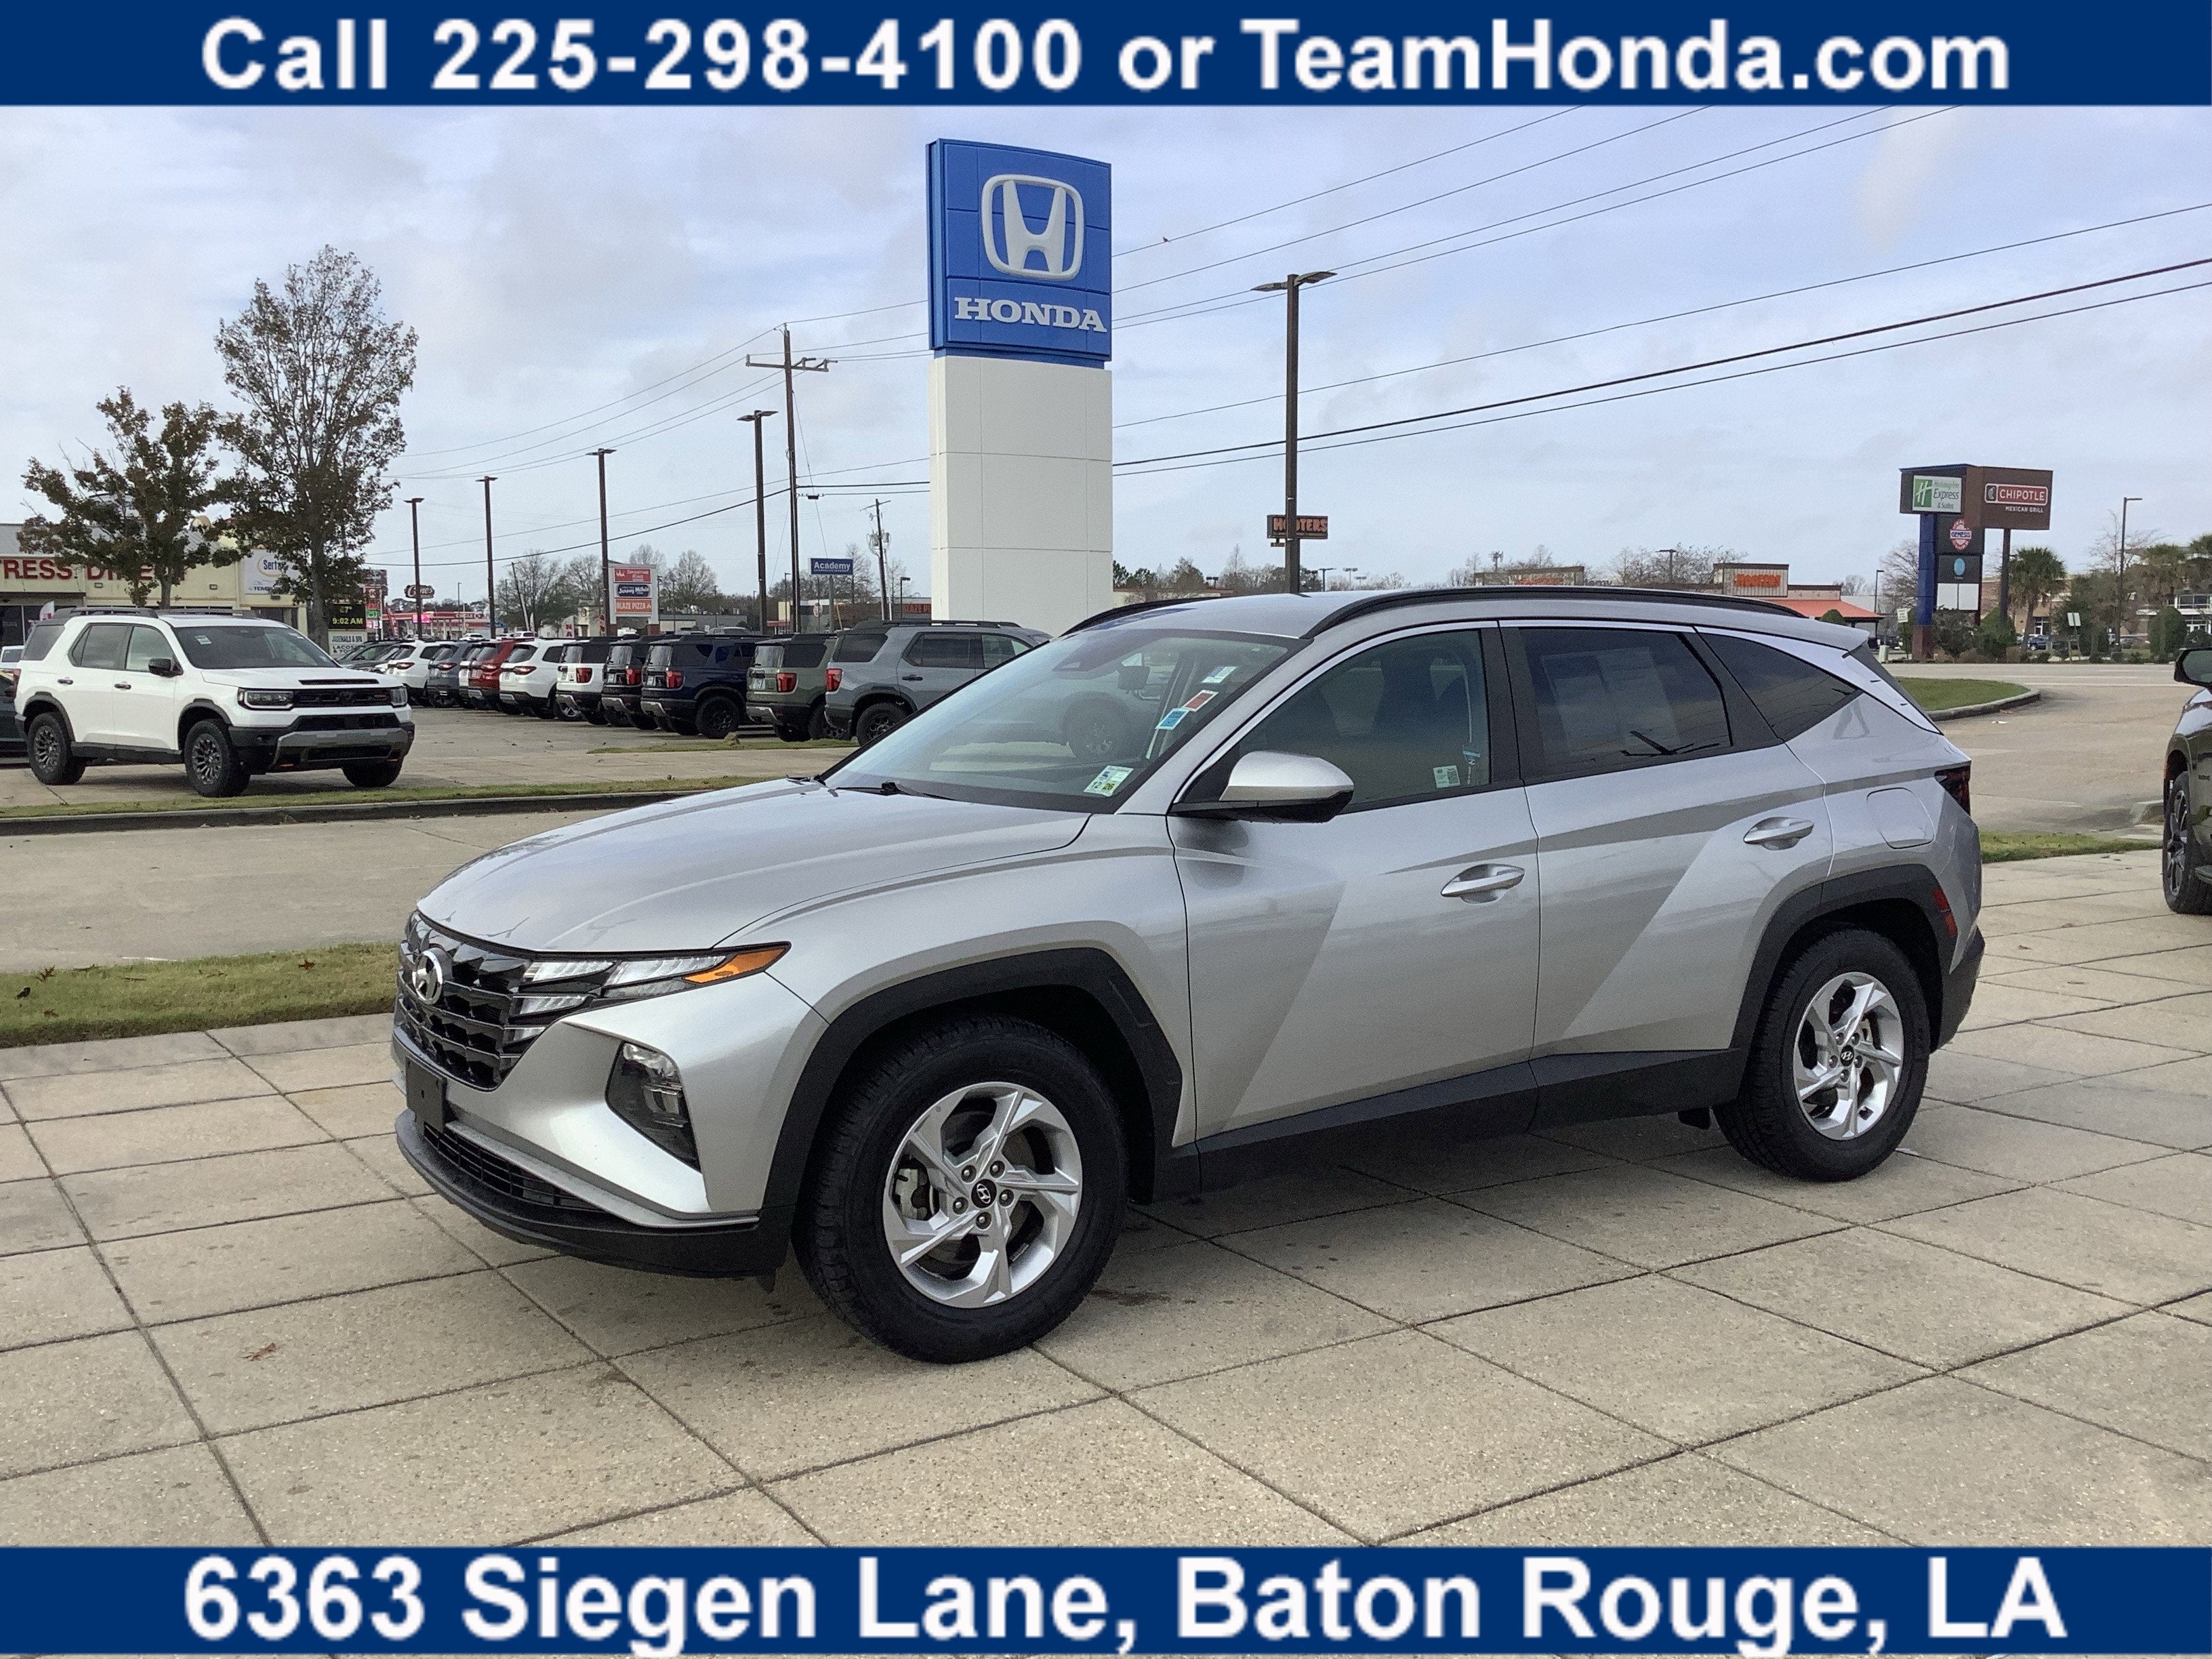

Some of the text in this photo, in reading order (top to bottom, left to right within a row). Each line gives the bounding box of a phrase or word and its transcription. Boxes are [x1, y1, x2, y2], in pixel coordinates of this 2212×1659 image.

[954, 297, 1107, 332] HONDA
[1933, 489, 1959, 501] Express
[1999, 489, 2045, 501] CHIPOTLE
[1273, 518, 1327, 532] HTERS
[0, 558, 74, 580] RESS
[814, 562, 851, 572] Academy
